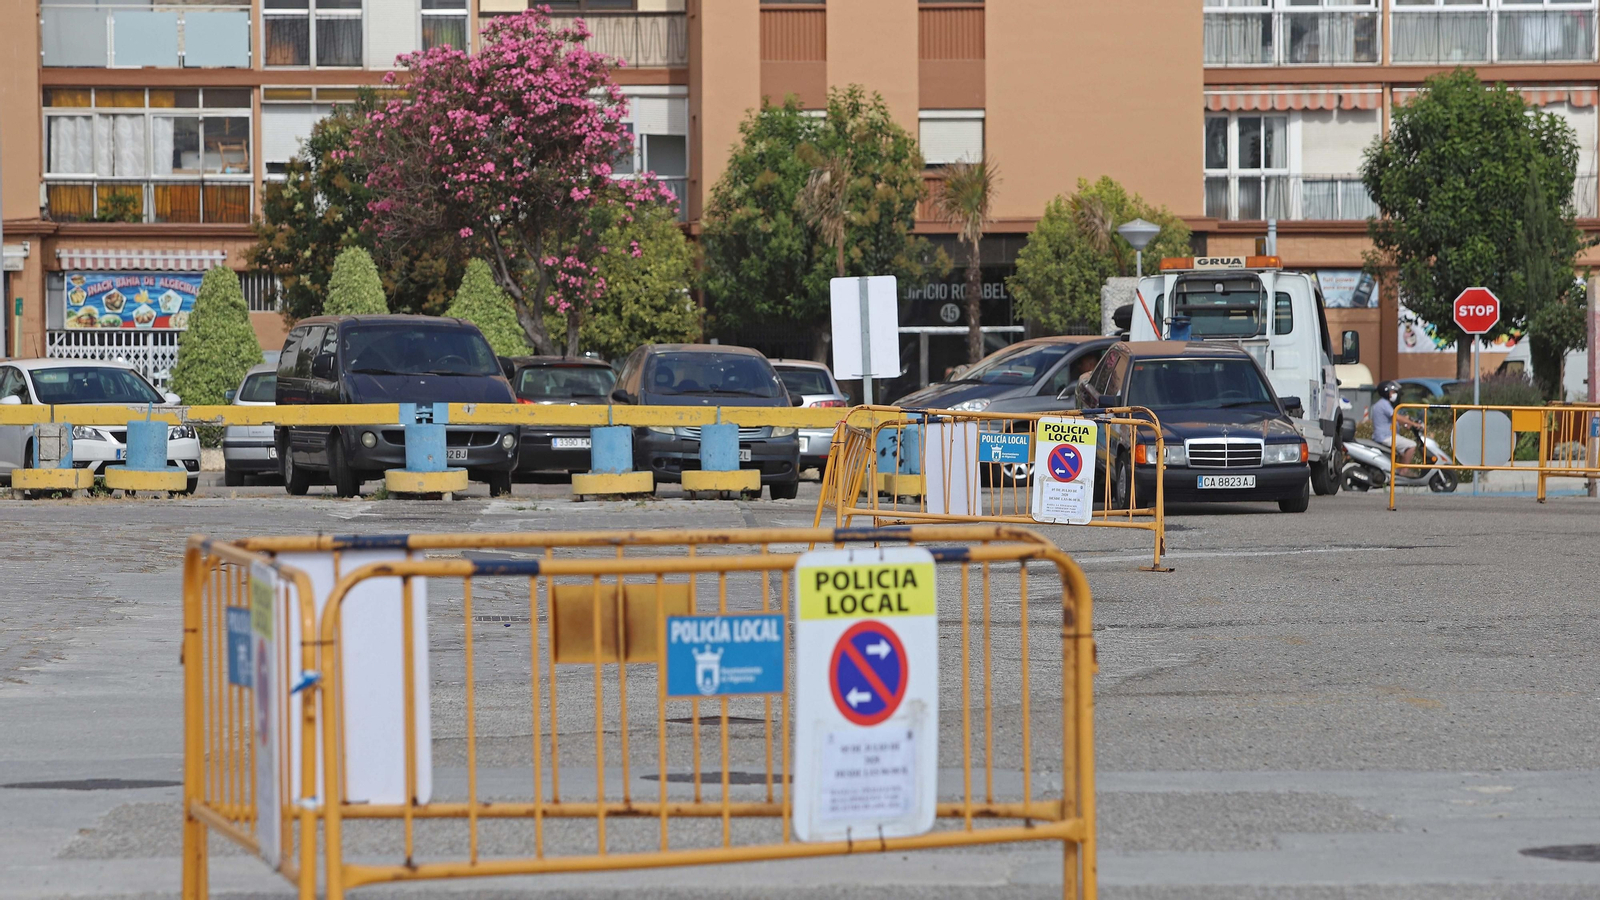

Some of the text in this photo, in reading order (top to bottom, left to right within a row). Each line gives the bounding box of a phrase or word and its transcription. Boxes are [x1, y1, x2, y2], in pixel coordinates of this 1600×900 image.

[87, 279, 113, 297] SNACK
[115, 276, 140, 288] BAHIA
[942, 305, 956, 320] 45
[1458, 305, 1495, 317] STOP
[1044, 424, 1090, 435] POLICIA
[559, 438, 578, 446] 3390
[981, 434, 1027, 445] POLICÍA LOCAL
[1048, 433, 1085, 443] LOCAL
[455, 450, 467, 459] BJ
[1203, 477, 1255, 487] CA 8823 AJ
[815, 568, 918, 591] POLICIA
[826, 593, 909, 615] LOCAL
[671, 617, 781, 644] POLICÍA LOCAL
